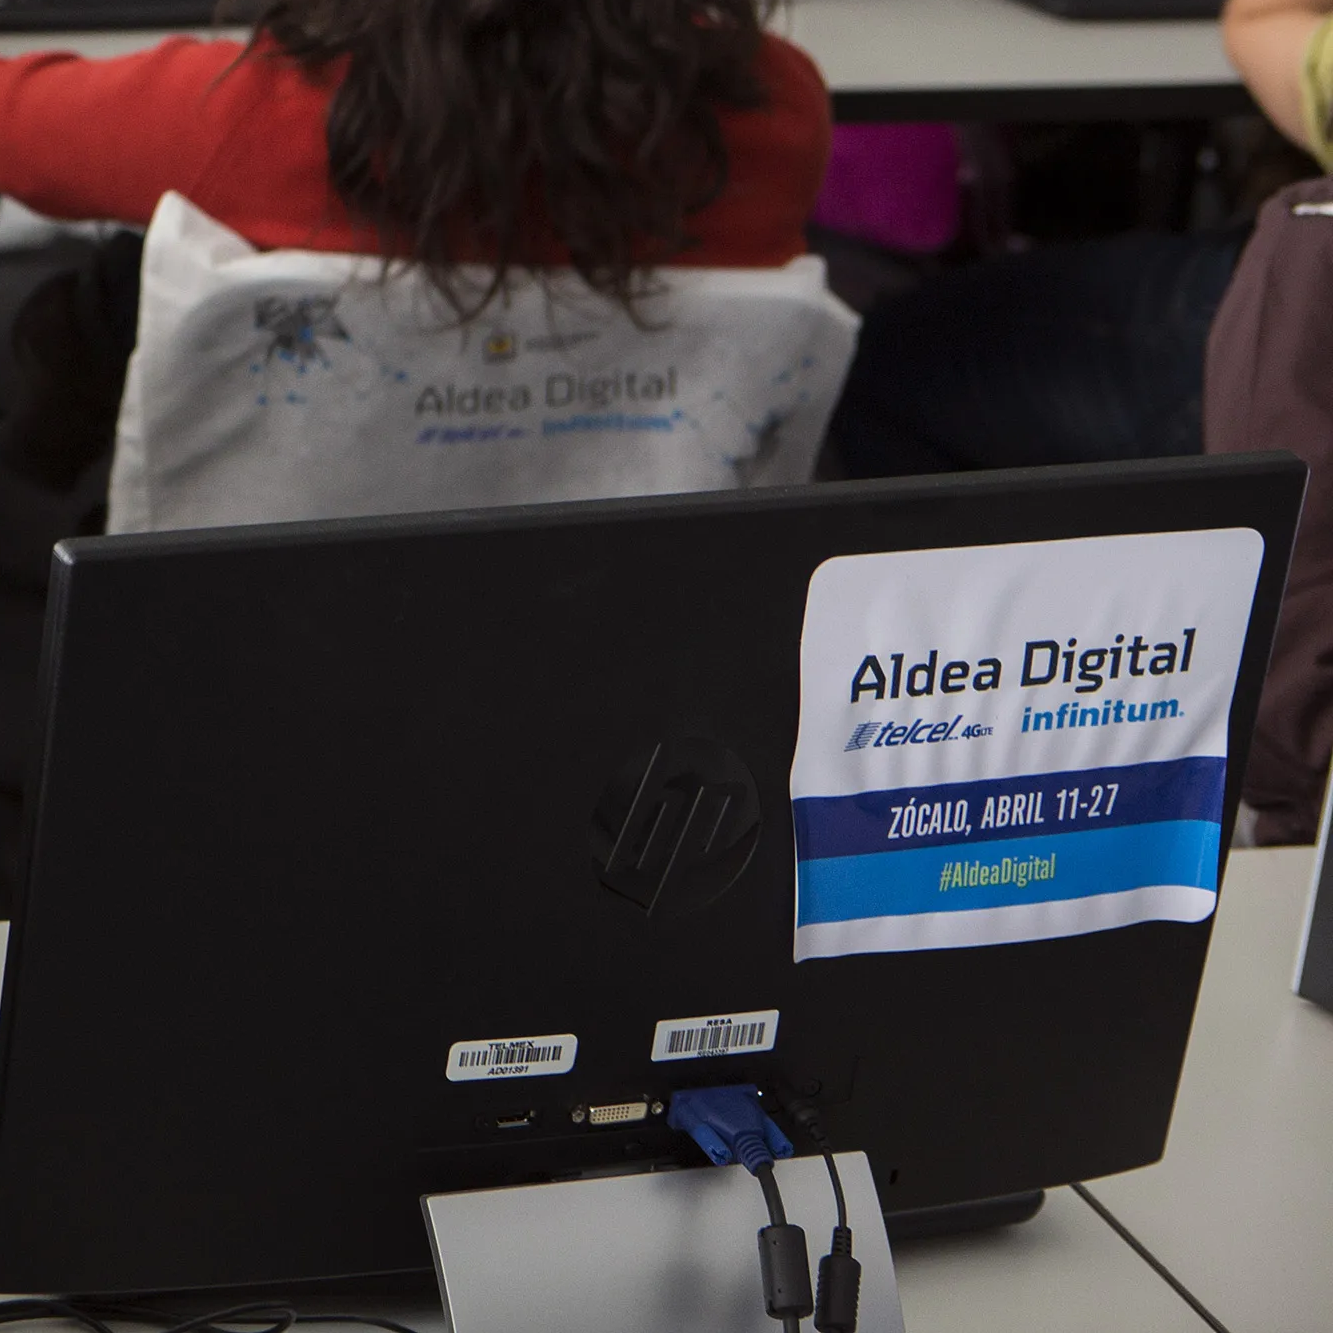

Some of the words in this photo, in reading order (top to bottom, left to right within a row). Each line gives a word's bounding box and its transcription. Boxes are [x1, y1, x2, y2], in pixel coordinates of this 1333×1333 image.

[416, 383, 530, 417] Aldea
[545, 370, 678, 408] Digital
[850, 650, 1002, 703] Aldea
[1020, 628, 1196, 693] Digital
[873, 715, 963, 747] telcel
[887, 798, 972, 840] ZÓCALO,
[981, 792, 1045, 829] ABRIL
[1056, 783, 1119, 821] 11-27
[939, 853, 1056, 892] #AldeaDigital
[707, 1018, 733, 1027] RESA
[488, 1040, 535, 1050] TELMEX
